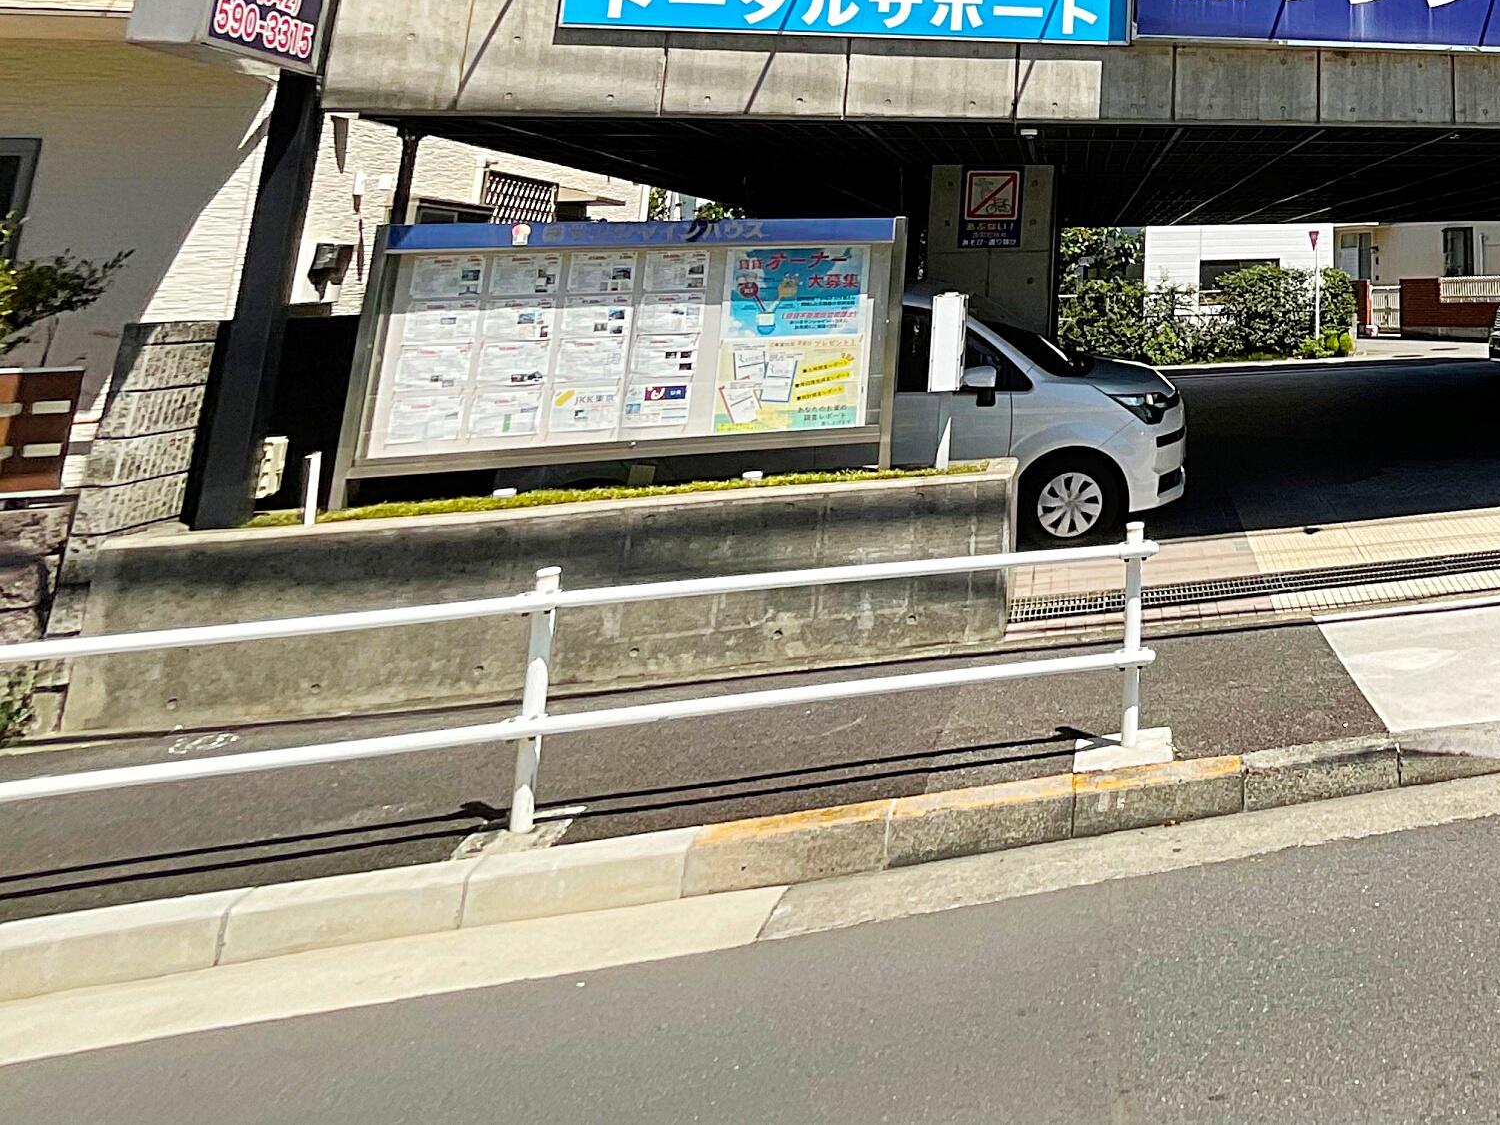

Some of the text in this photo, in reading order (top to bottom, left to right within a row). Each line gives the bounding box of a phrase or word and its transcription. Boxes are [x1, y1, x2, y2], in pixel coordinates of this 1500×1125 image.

[765, 251, 848, 271] オーナー
[808, 273, 860, 289] 大募集
